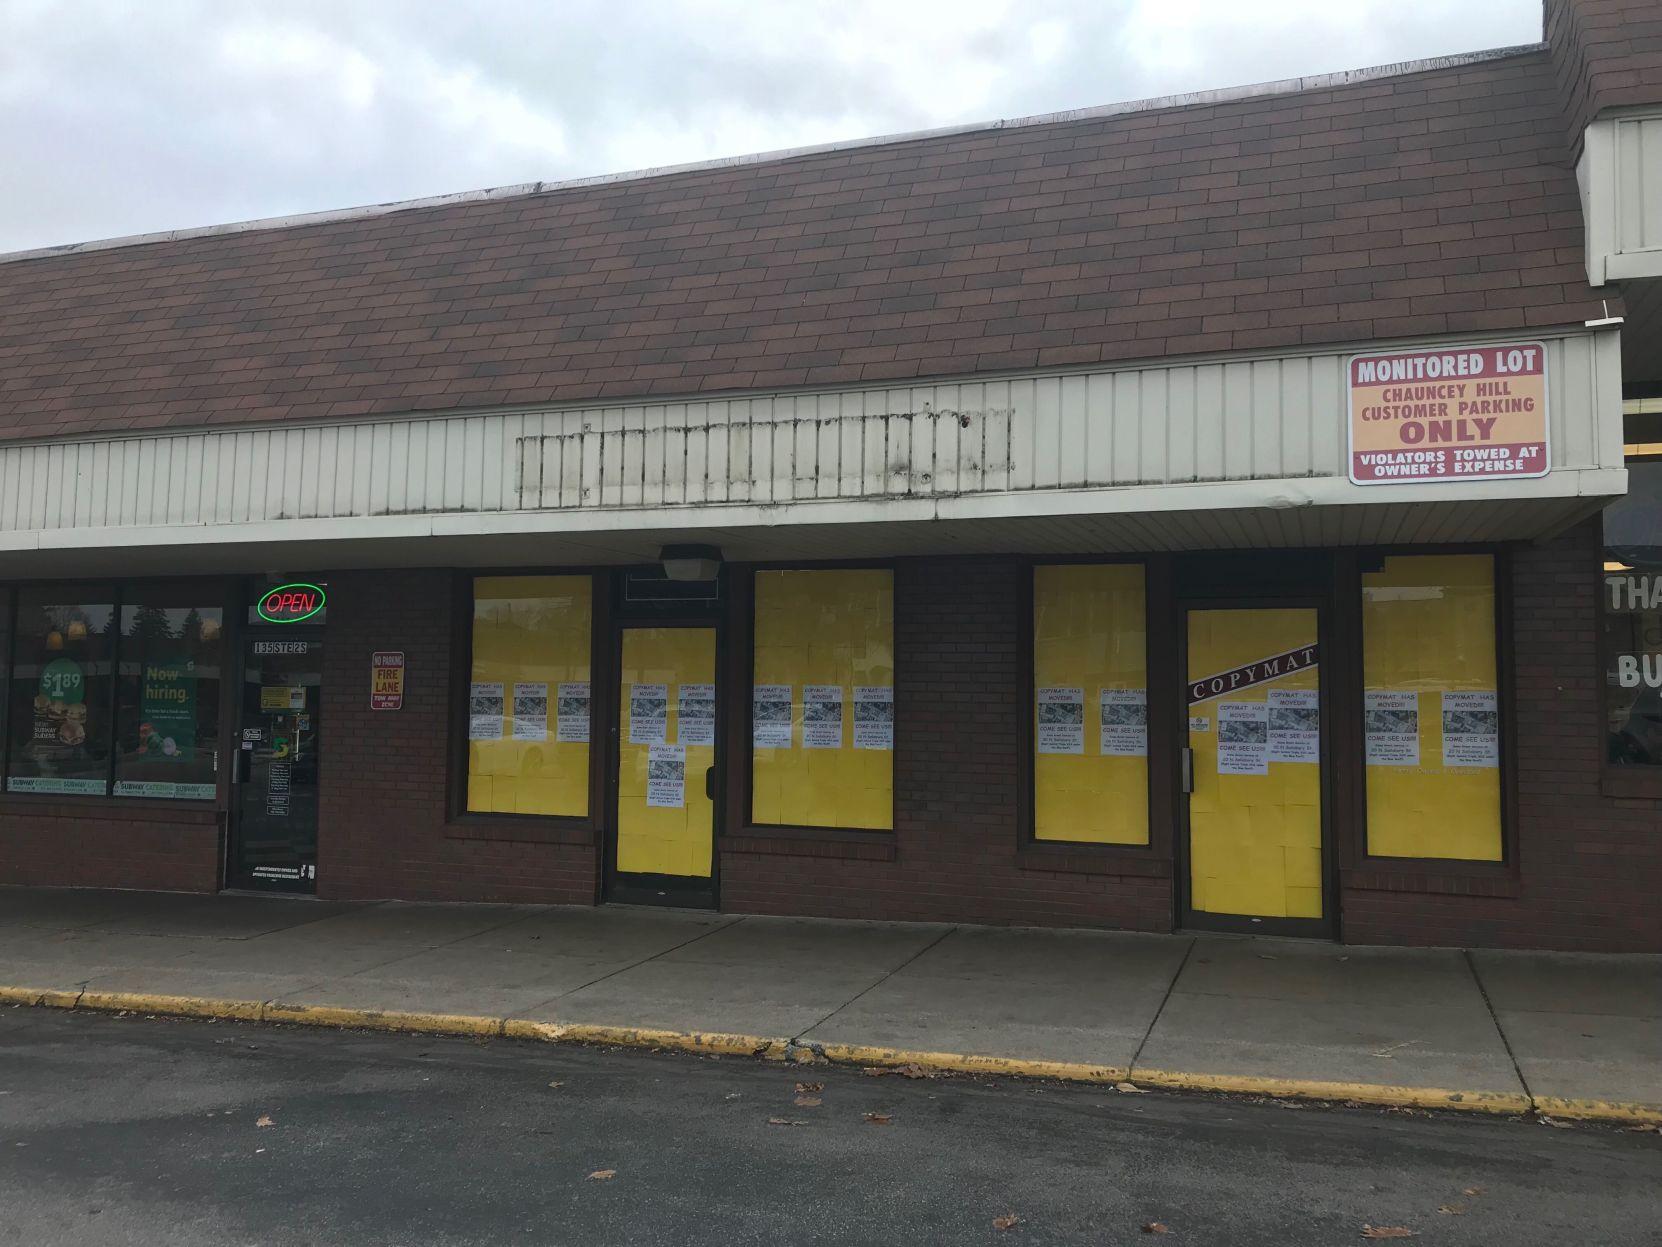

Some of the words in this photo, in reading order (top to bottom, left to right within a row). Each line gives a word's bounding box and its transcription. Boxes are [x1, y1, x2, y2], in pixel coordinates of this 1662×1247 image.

[1358, 353, 1484, 383] MONITORED
[1496, 350, 1536, 373] LOT
[1382, 384, 1467, 402] CHAUNCEY
[1476, 381, 1511, 396] HILL
[1361, 401, 1448, 421] CUSTOMER
[1458, 398, 1535, 416] PARKING
[1399, 418, 1497, 444] ONLY
[1360, 451, 1446, 466] VIOLATORS
[1454, 448, 1510, 462] TOWED
[1518, 446, 1539, 458] AT
[1374, 462, 1446, 476] OWNER'S
[1454, 459, 1524, 472] EXPENSE
[266, 593, 316, 613] OPEN
[374, 656, 382, 666] NO
[382, 656, 402, 666] PARKING
[146, 667, 178, 680] Now
[378, 669, 398, 680] FIRE
[1193, 648, 1314, 699] COPYMAT
[146, 684, 190, 703] hiring.
[376, 682, 400, 692] LANE
